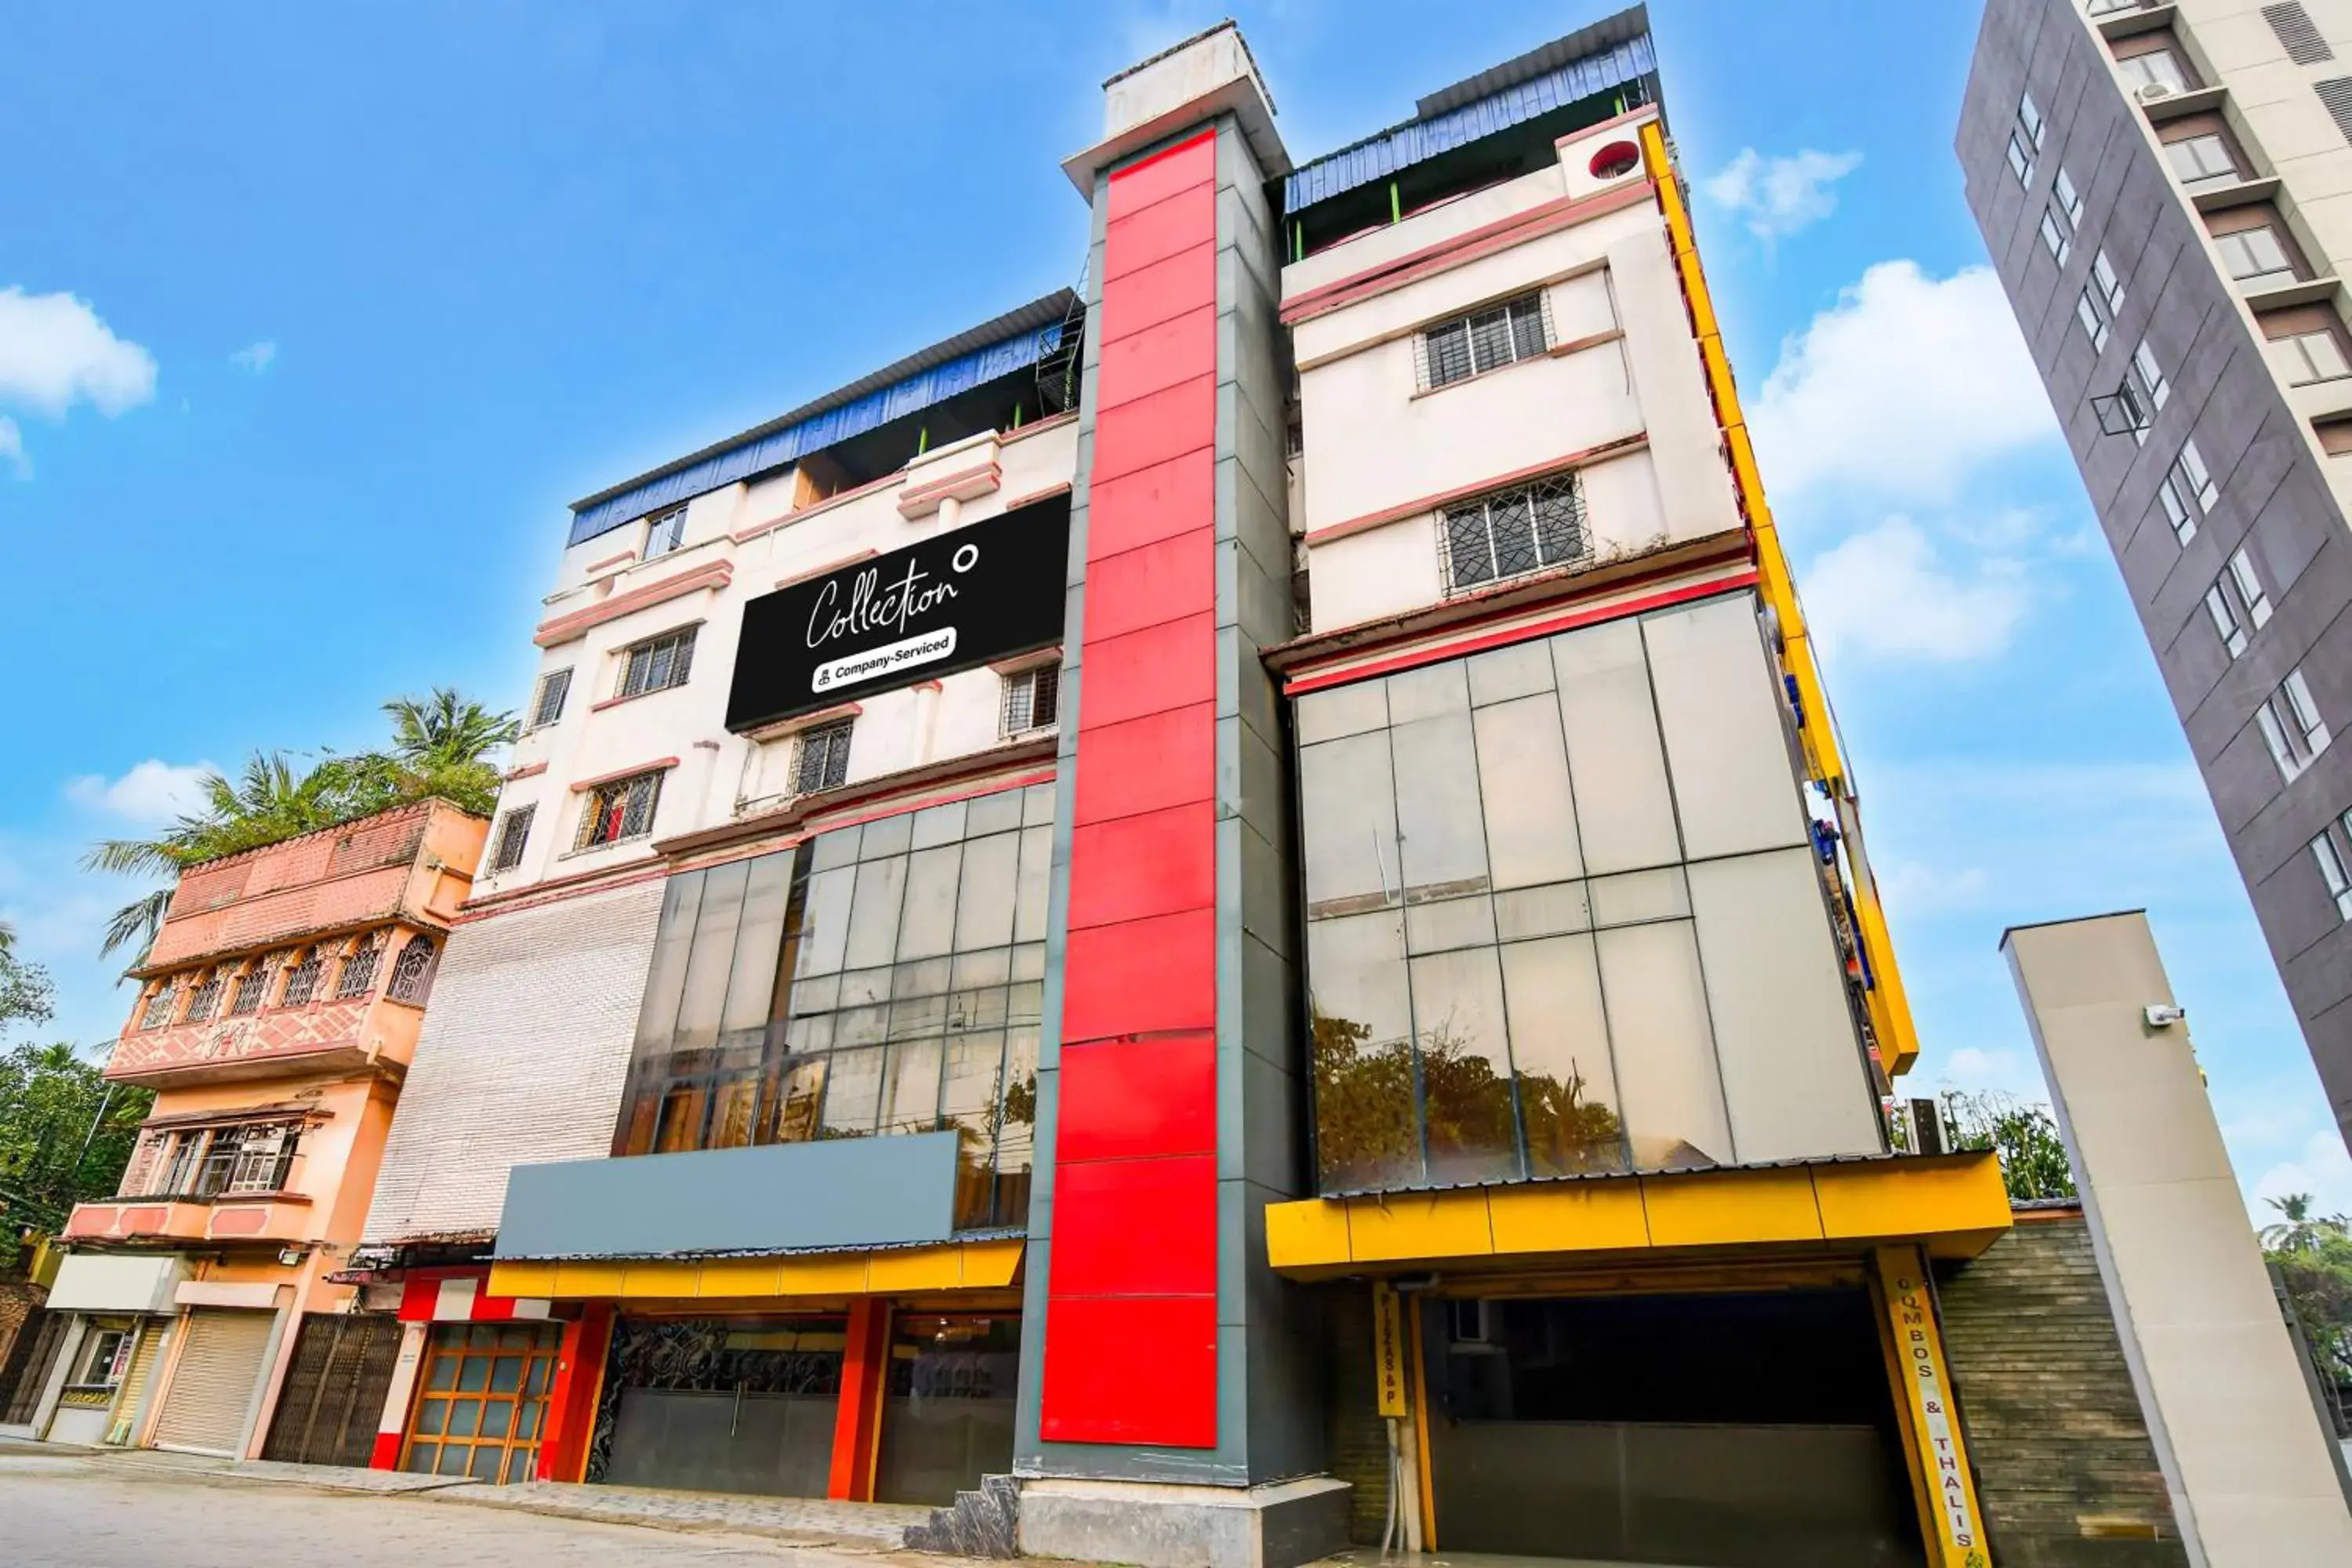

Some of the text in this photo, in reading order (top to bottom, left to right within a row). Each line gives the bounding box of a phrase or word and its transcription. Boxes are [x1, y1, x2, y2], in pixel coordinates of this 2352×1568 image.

[807, 557, 958, 648] Collection
[835, 636, 949, 679] Company-Serviced
[1926, 1401, 1941, 1414] &
[1934, 1438, 1972, 1547] THALIS
